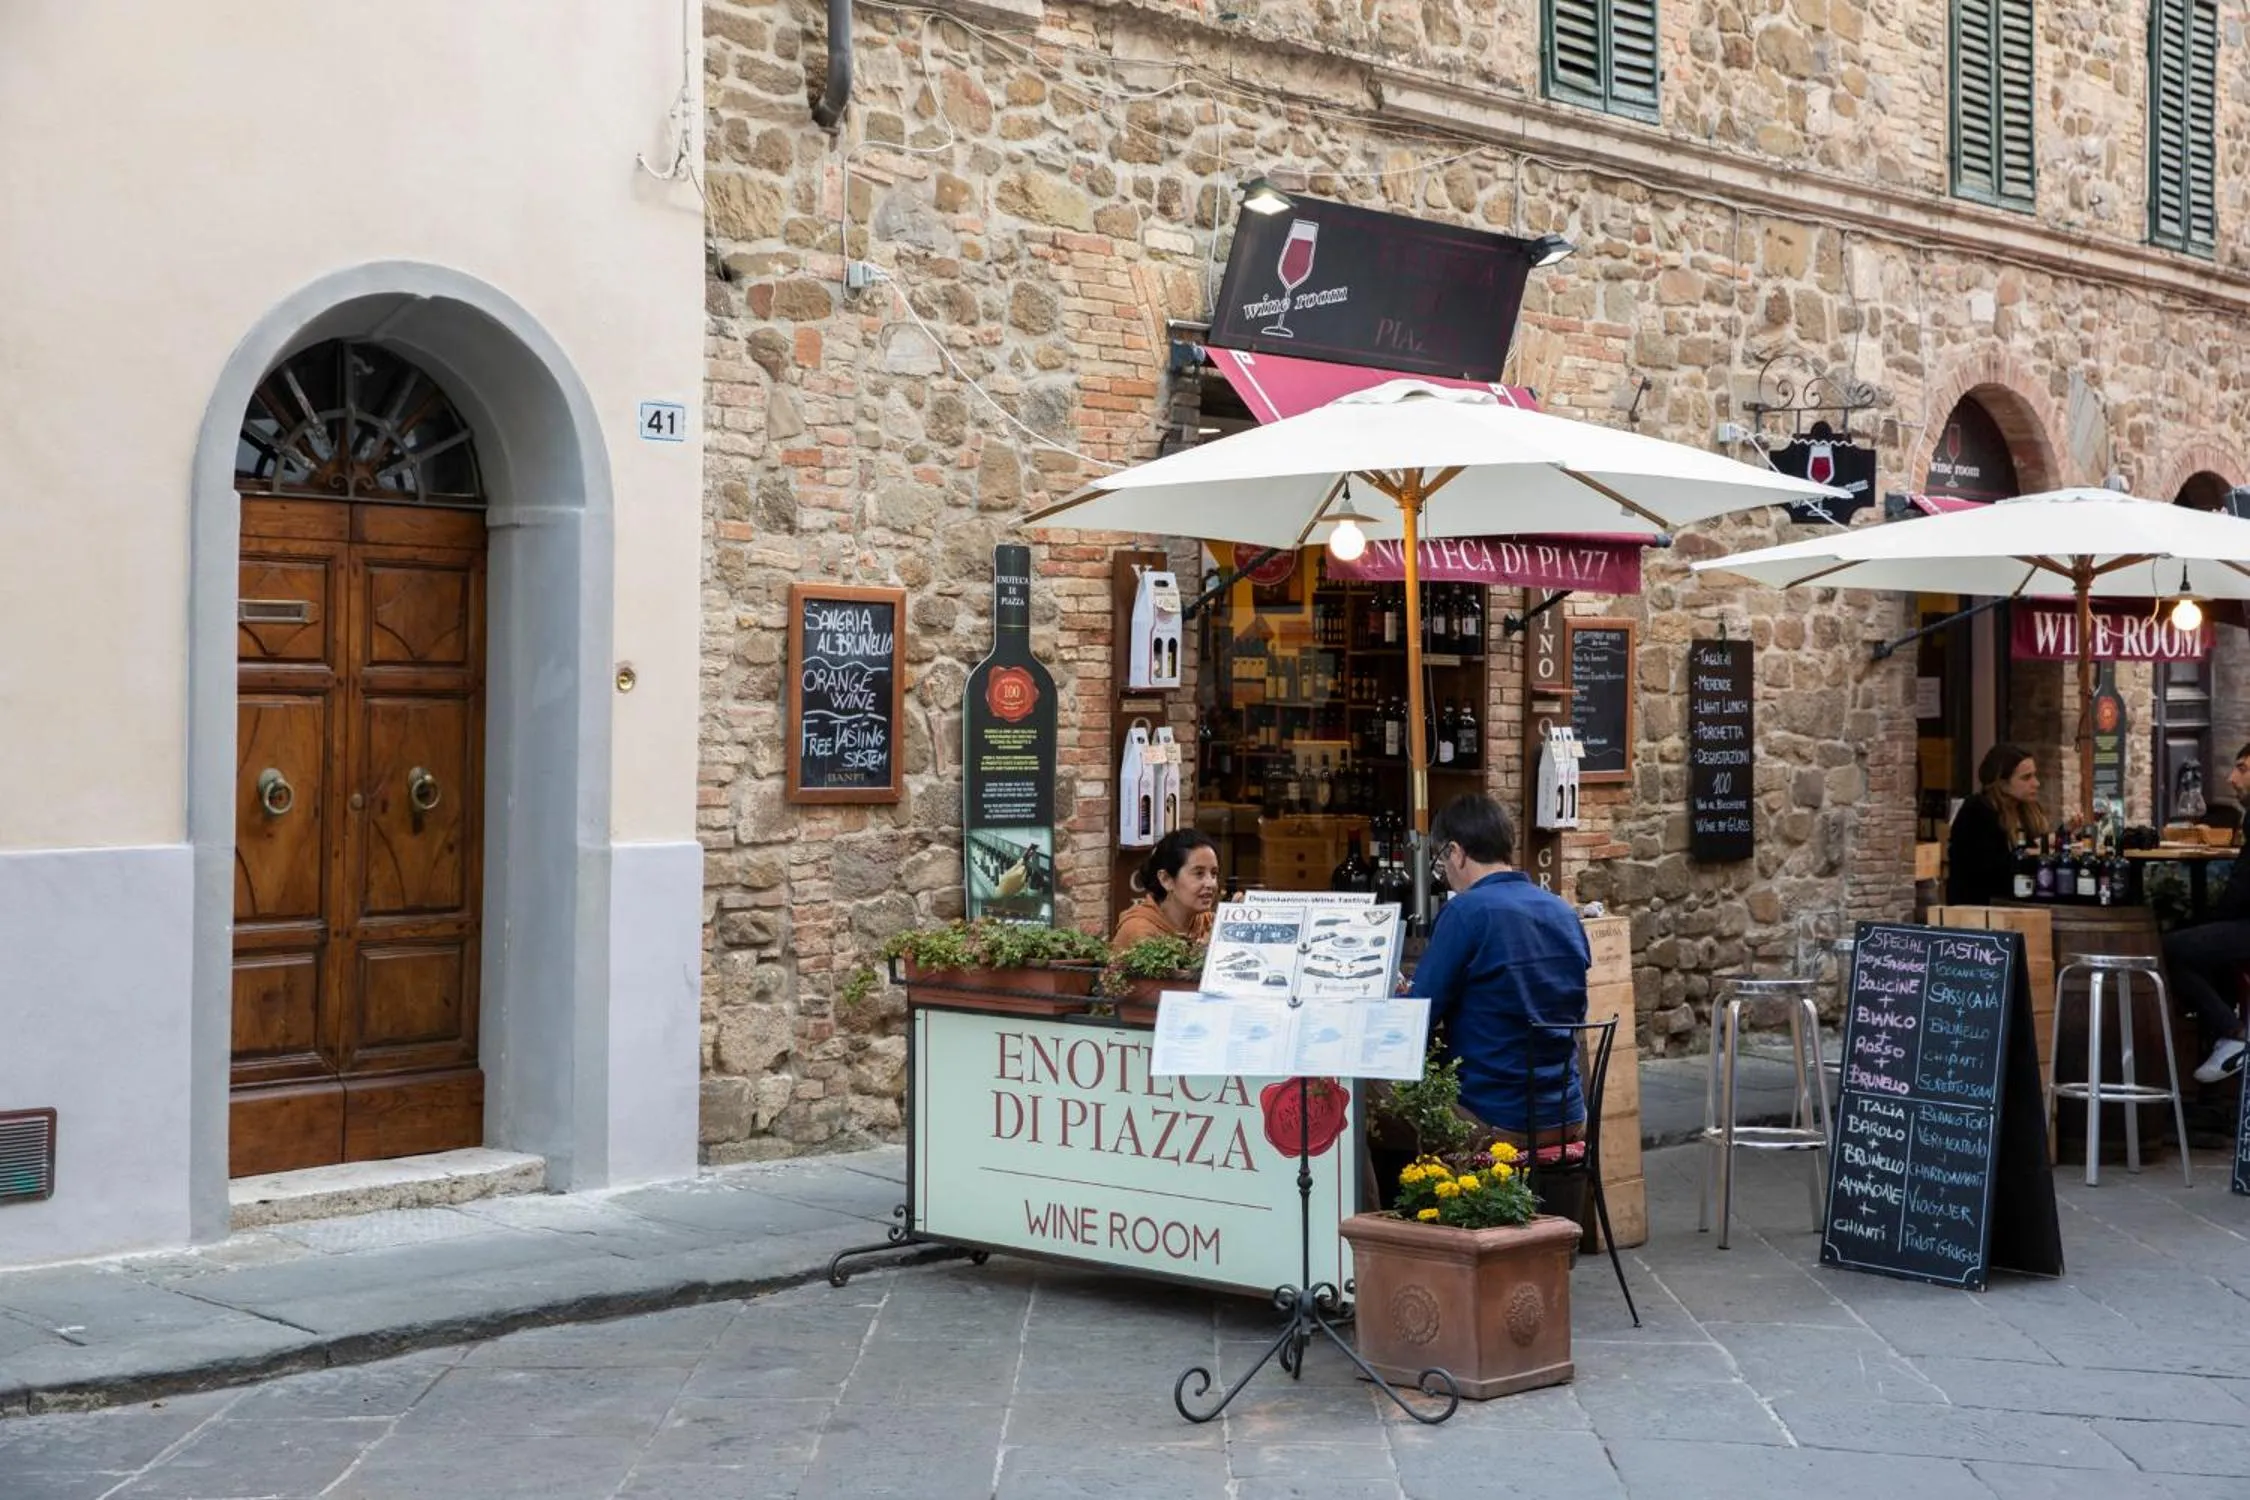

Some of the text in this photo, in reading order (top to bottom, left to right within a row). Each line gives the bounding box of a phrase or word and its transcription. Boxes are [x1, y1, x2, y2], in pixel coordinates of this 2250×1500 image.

[1243, 286, 1348, 320] wine room
[647, 410, 675, 434] 41
[1500, 542, 1531, 576] DI
[2033, 611, 2203, 658] WIE ROOM
[802, 668, 874, 693] ORANGE
[1003, 684, 1020, 698] 100
[830, 692, 877, 711] WINE
[1223, 908, 1262, 922] 100
[1855, 1036, 1906, 1059] ROSSO
[991, 1089, 1043, 1144] DI
[1057, 1097, 1260, 1173] PIAZZA
[1847, 1114, 1905, 1141] BAROLO
[1024, 1199, 1220, 1266] WINE ROOM
